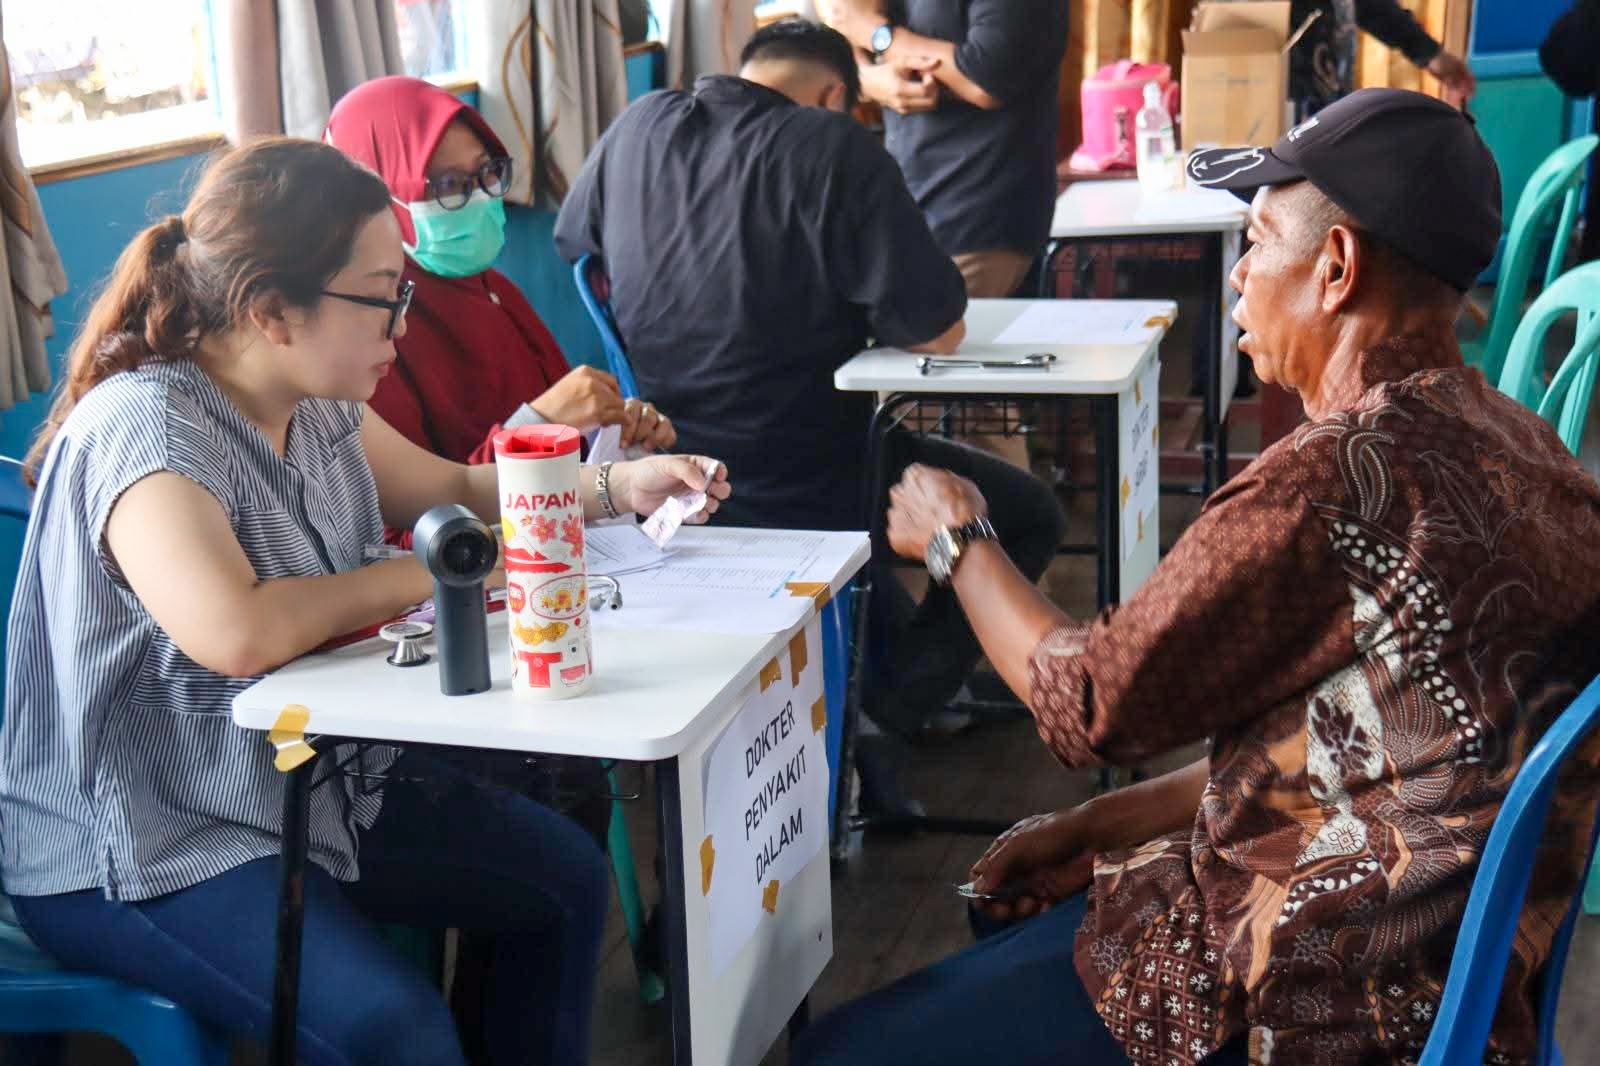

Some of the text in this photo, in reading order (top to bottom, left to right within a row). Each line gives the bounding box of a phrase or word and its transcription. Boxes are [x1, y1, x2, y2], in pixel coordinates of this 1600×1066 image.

[506, 488, 576, 511] JAPAN
[745, 700, 796, 779] DOKTER
[744, 743, 807, 842] PENYAKIT
[755, 807, 804, 886] DALAM
